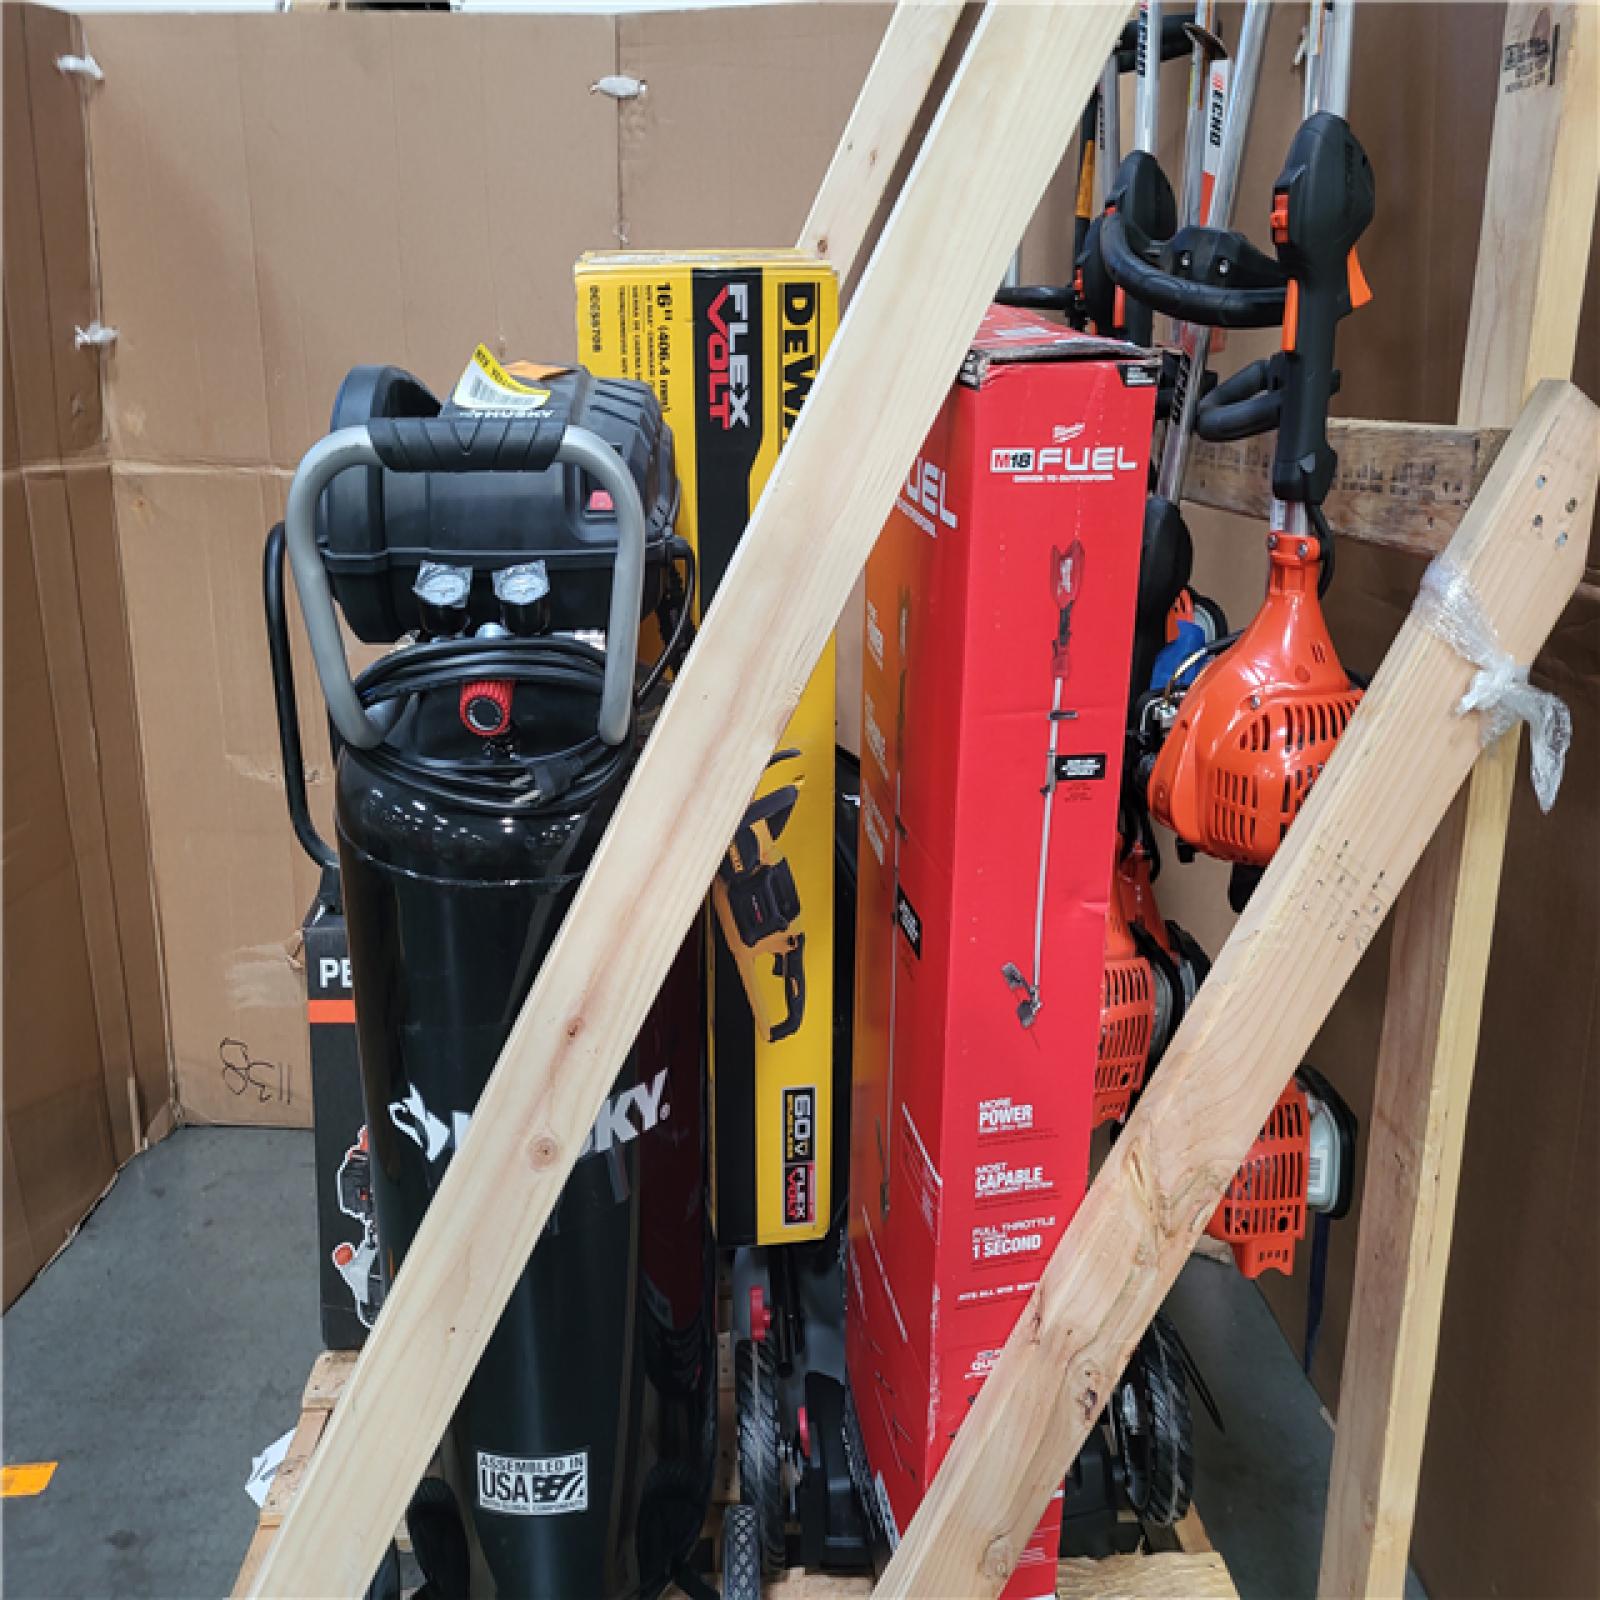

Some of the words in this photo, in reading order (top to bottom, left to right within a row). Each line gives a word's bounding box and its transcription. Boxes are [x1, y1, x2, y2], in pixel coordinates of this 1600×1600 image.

[1209, 89, 1224, 148] ECHO
[657, 282, 673, 321] 16"
[707, 285, 730, 431] VOLT
[728, 282, 749, 428] FLEX
[992, 450, 1032, 470] M18
[1037, 447, 1138, 472] FUEL
[904, 456, 958, 529] UEL
[979, 1104, 1033, 1127] POWER
[984, 1234, 1041, 1259] SECOND
[481, 1468, 529, 1503] USA
